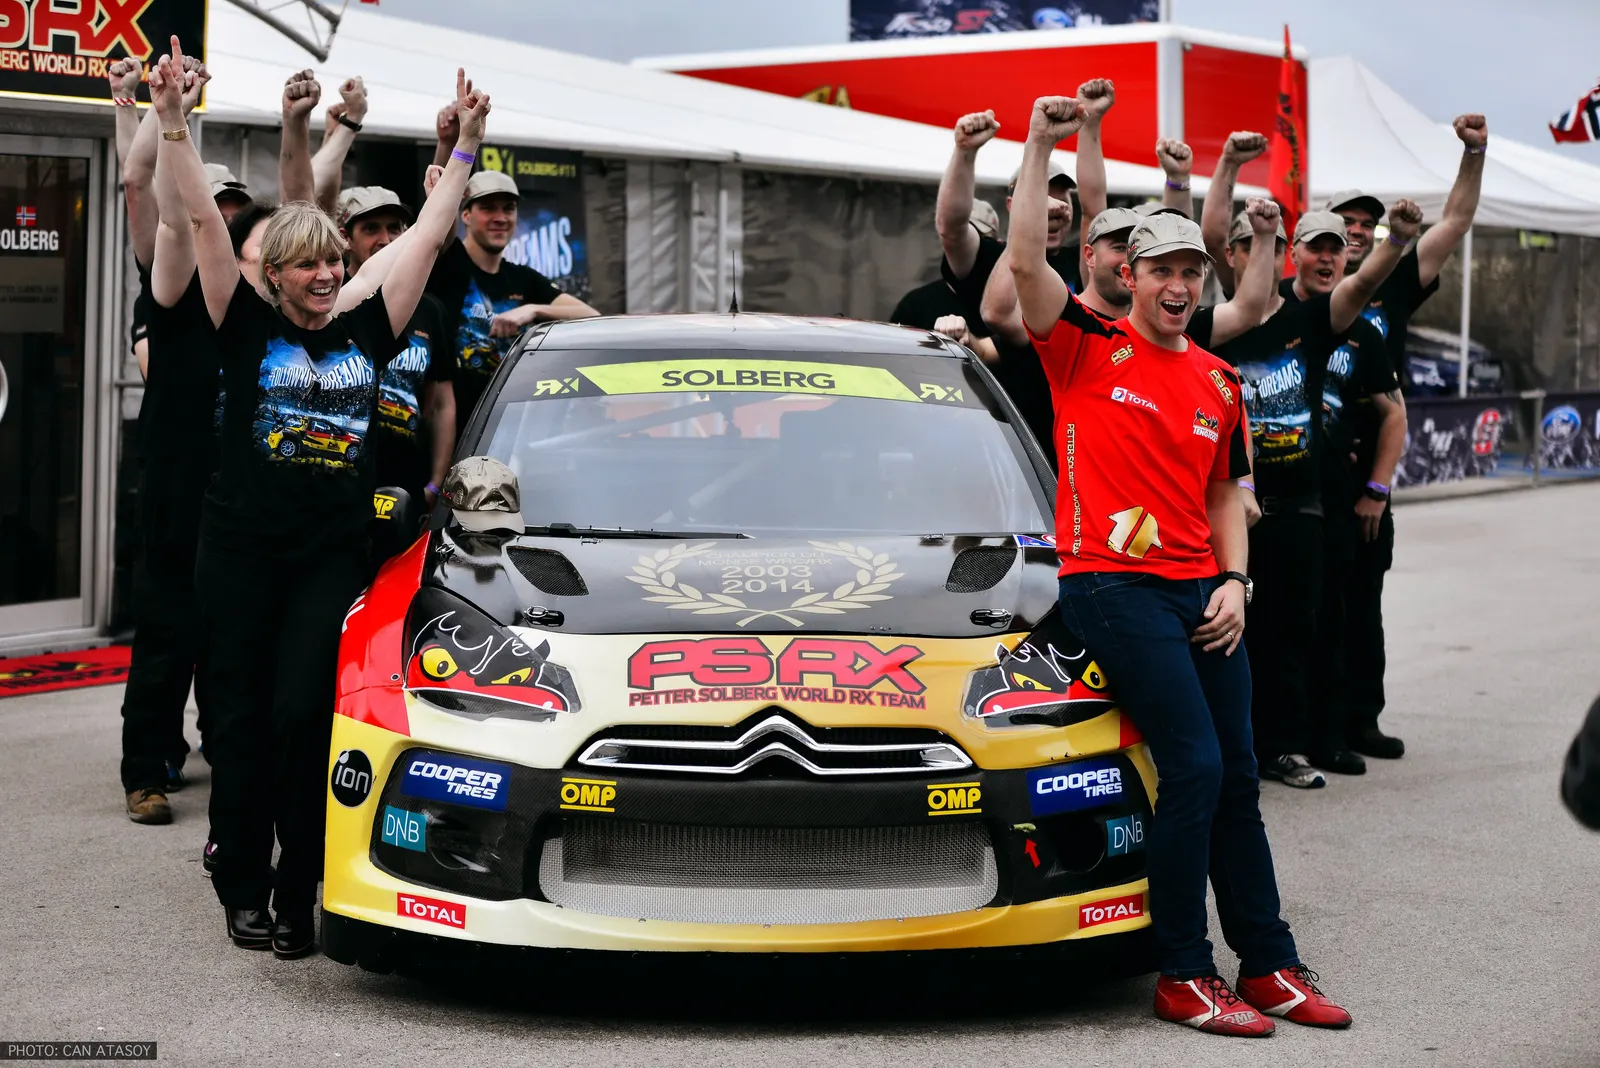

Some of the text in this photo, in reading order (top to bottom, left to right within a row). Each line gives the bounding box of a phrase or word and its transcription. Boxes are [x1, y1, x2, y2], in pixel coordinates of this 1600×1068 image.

[0, 50, 29, 70] ERG
[32, 52, 86, 76] WORLD
[0, 229, 59, 251] OLBERG
[662, 369, 836, 389] SOLBERG
[1128, 393, 1159, 411] TOTAL
[1067, 423, 1075, 455] PETTER
[1073, 493, 1081, 524] WORLD
[1073, 525, 1080, 536] RX
[699, 558, 760, 566] MONDE
[706, 551, 825, 559] CHAMPION DU
[721, 565, 813, 578] 2003
[722, 579, 815, 593] 2014
[629, 686, 927, 710] PETTER SOLBERG WORLD RX TEAM
[335, 757, 370, 794] ion
[408, 760, 503, 789] COOPER
[1036, 767, 1122, 795] COOPER
[447, 781, 498, 800] TIRES
[561, 783, 616, 806] OMP
[927, 787, 982, 810] OMP
[1083, 782, 1123, 798] TIRES
[385, 810, 420, 846] DNB
[1113, 815, 1144, 853] DNB
[400, 897, 462, 924] TOTAL
[1081, 902, 1140, 923] TOTAL
